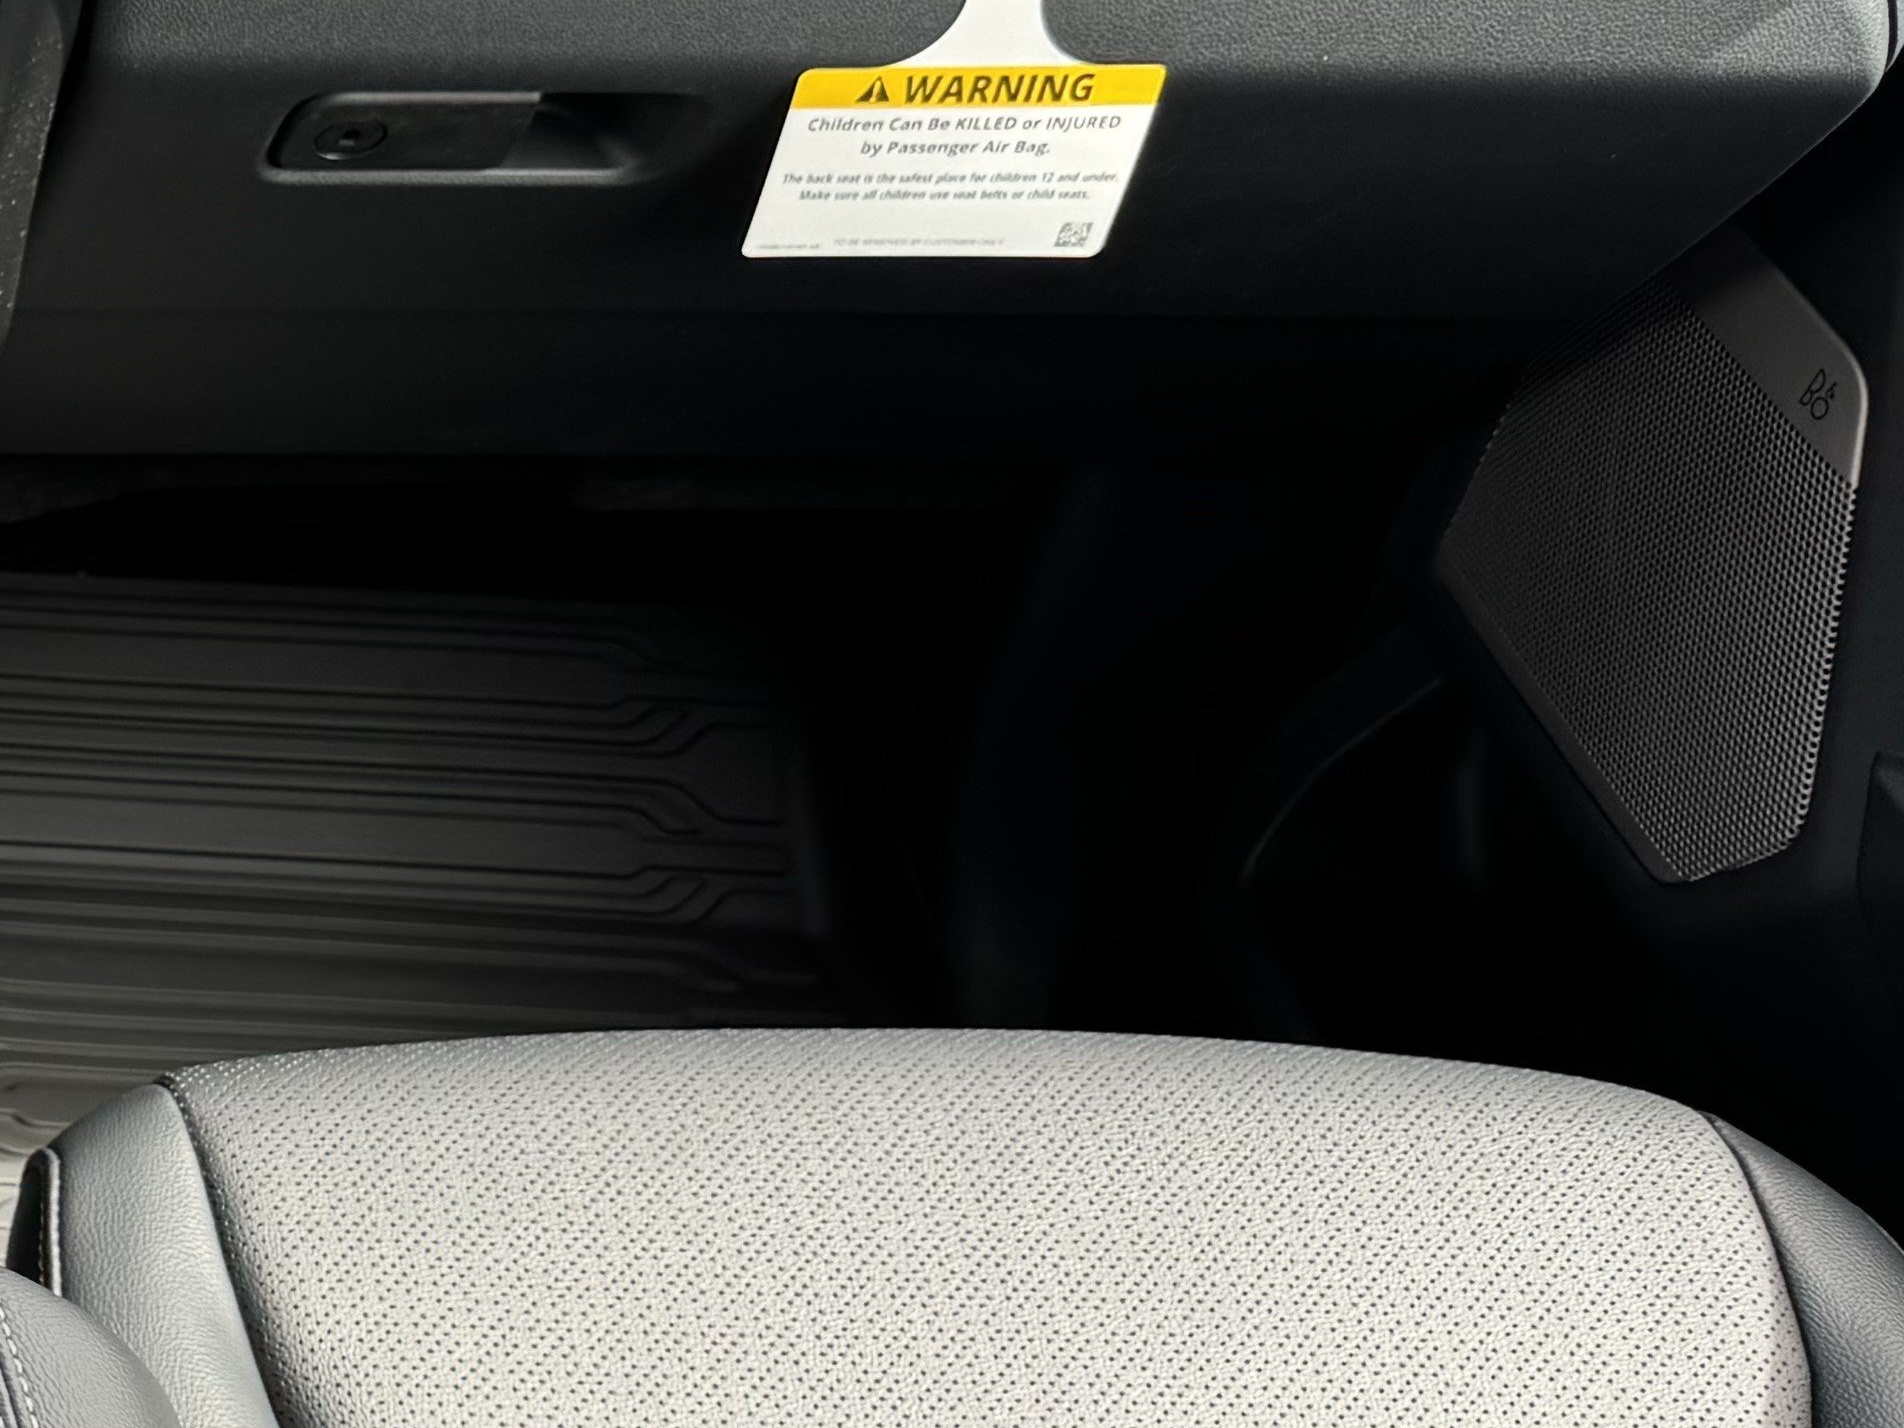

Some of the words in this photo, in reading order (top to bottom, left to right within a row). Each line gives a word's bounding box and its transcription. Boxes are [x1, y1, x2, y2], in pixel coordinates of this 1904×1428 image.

[905, 73, 1095, 104] WARNING
[808, 117, 884, 132] Children
[889, 118, 922, 132] Can
[927, 118, 950, 131] Be
[955, 116, 1017, 131] KILLED
[1022, 118, 1042, 130] or
[1046, 116, 1122, 133] INJURED
[860, 140, 882, 157] by
[887, 141, 978, 157] Passenger
[982, 140, 1010, 154] Air
[1014, 140, 1050, 156] Bag.
[783, 173, 803, 184] The
[806, 173, 833, 184] back
[836, 173, 861, 184] seat
[863, 174, 873, 184] is
[876, 173, 896, 184] the
[899, 173, 933, 184] safest
[934, 172, 966, 185] place
[970, 172, 987, 183] for
[990, 172, 1036, 183] children
[1057, 172, 1080, 182] and
[799, 190, 831, 200] Make
[834, 191, 859, 200] sure
[862, 190, 877, 200] all
[879, 190, 927, 201] children
[929, 191, 949, 200] use
[953, 190, 976, 200] seat
[1011, 190, 1024, 199] or
[1027, 189, 1055, 199] child
